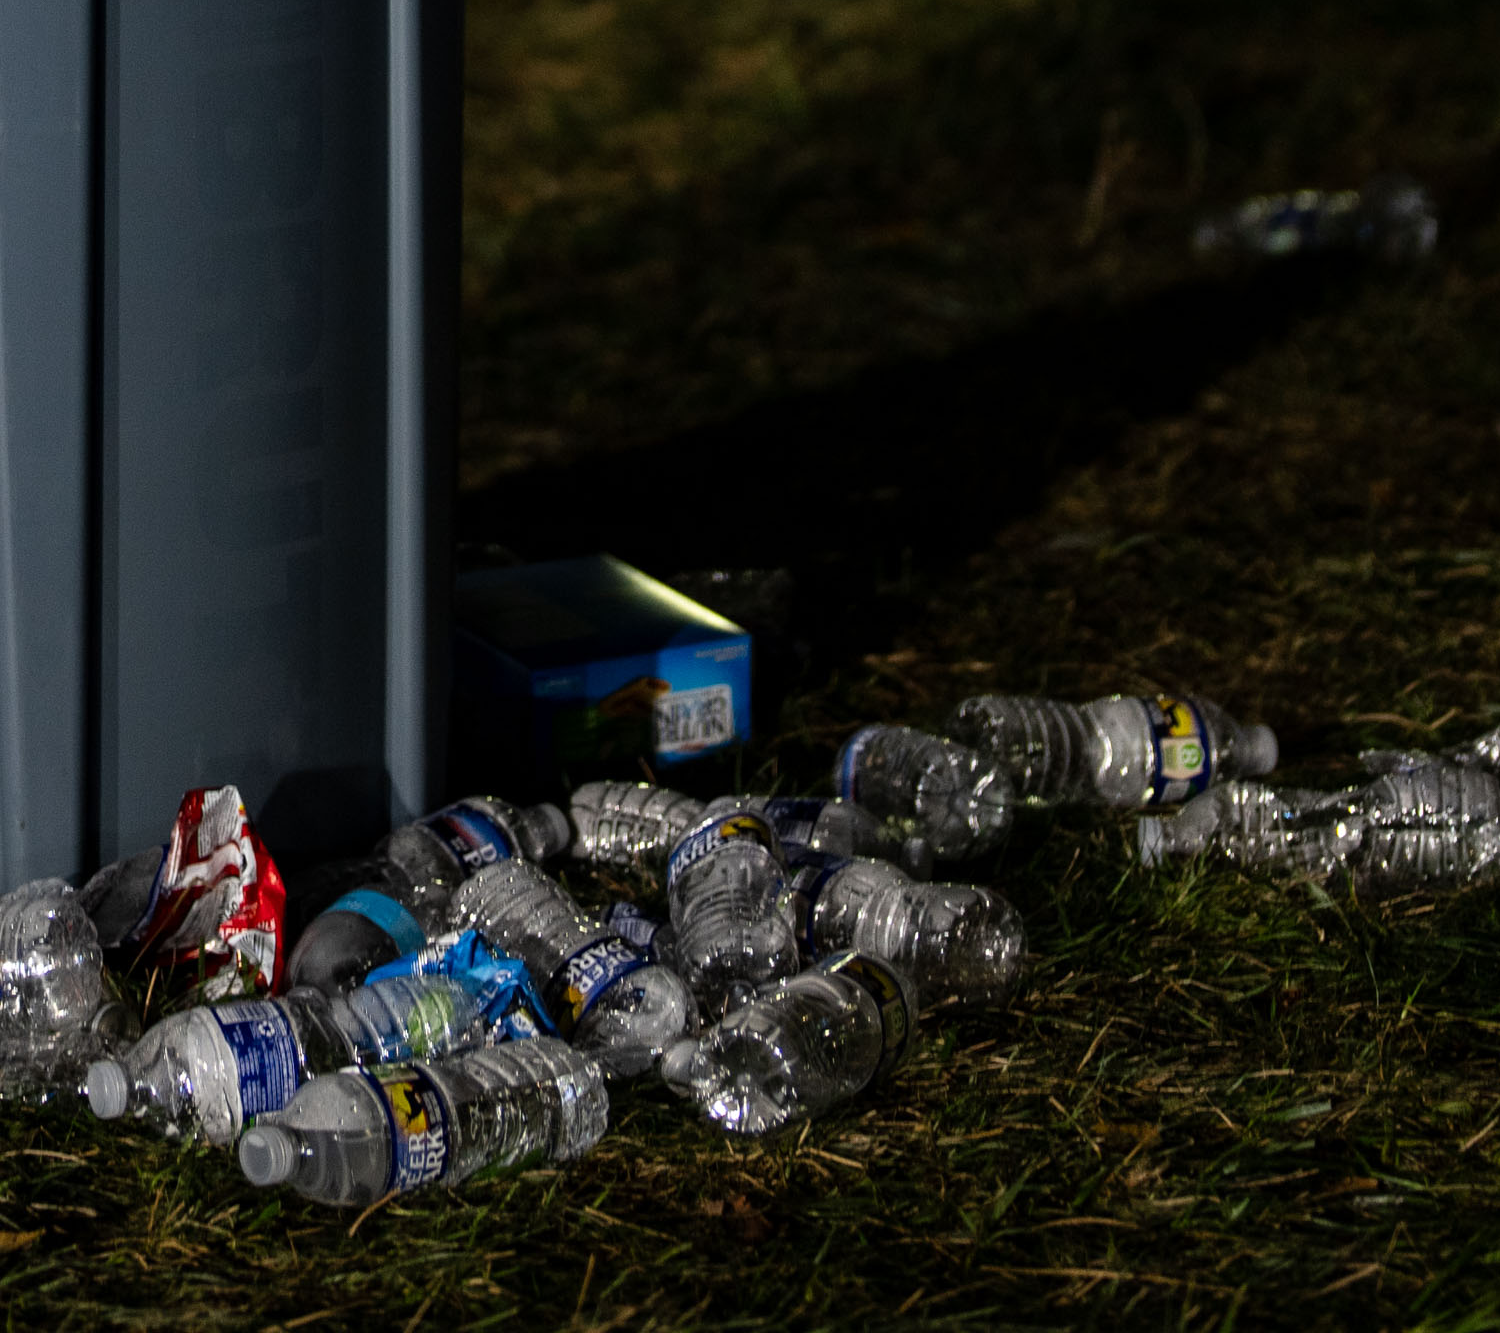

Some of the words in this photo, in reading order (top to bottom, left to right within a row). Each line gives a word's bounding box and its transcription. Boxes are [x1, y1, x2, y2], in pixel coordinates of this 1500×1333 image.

[566, 940, 625, 984] PARK
[579, 950, 638, 994] DEER
[406, 1133, 426, 1190] EER
[421, 1127, 447, 1182] ARK
